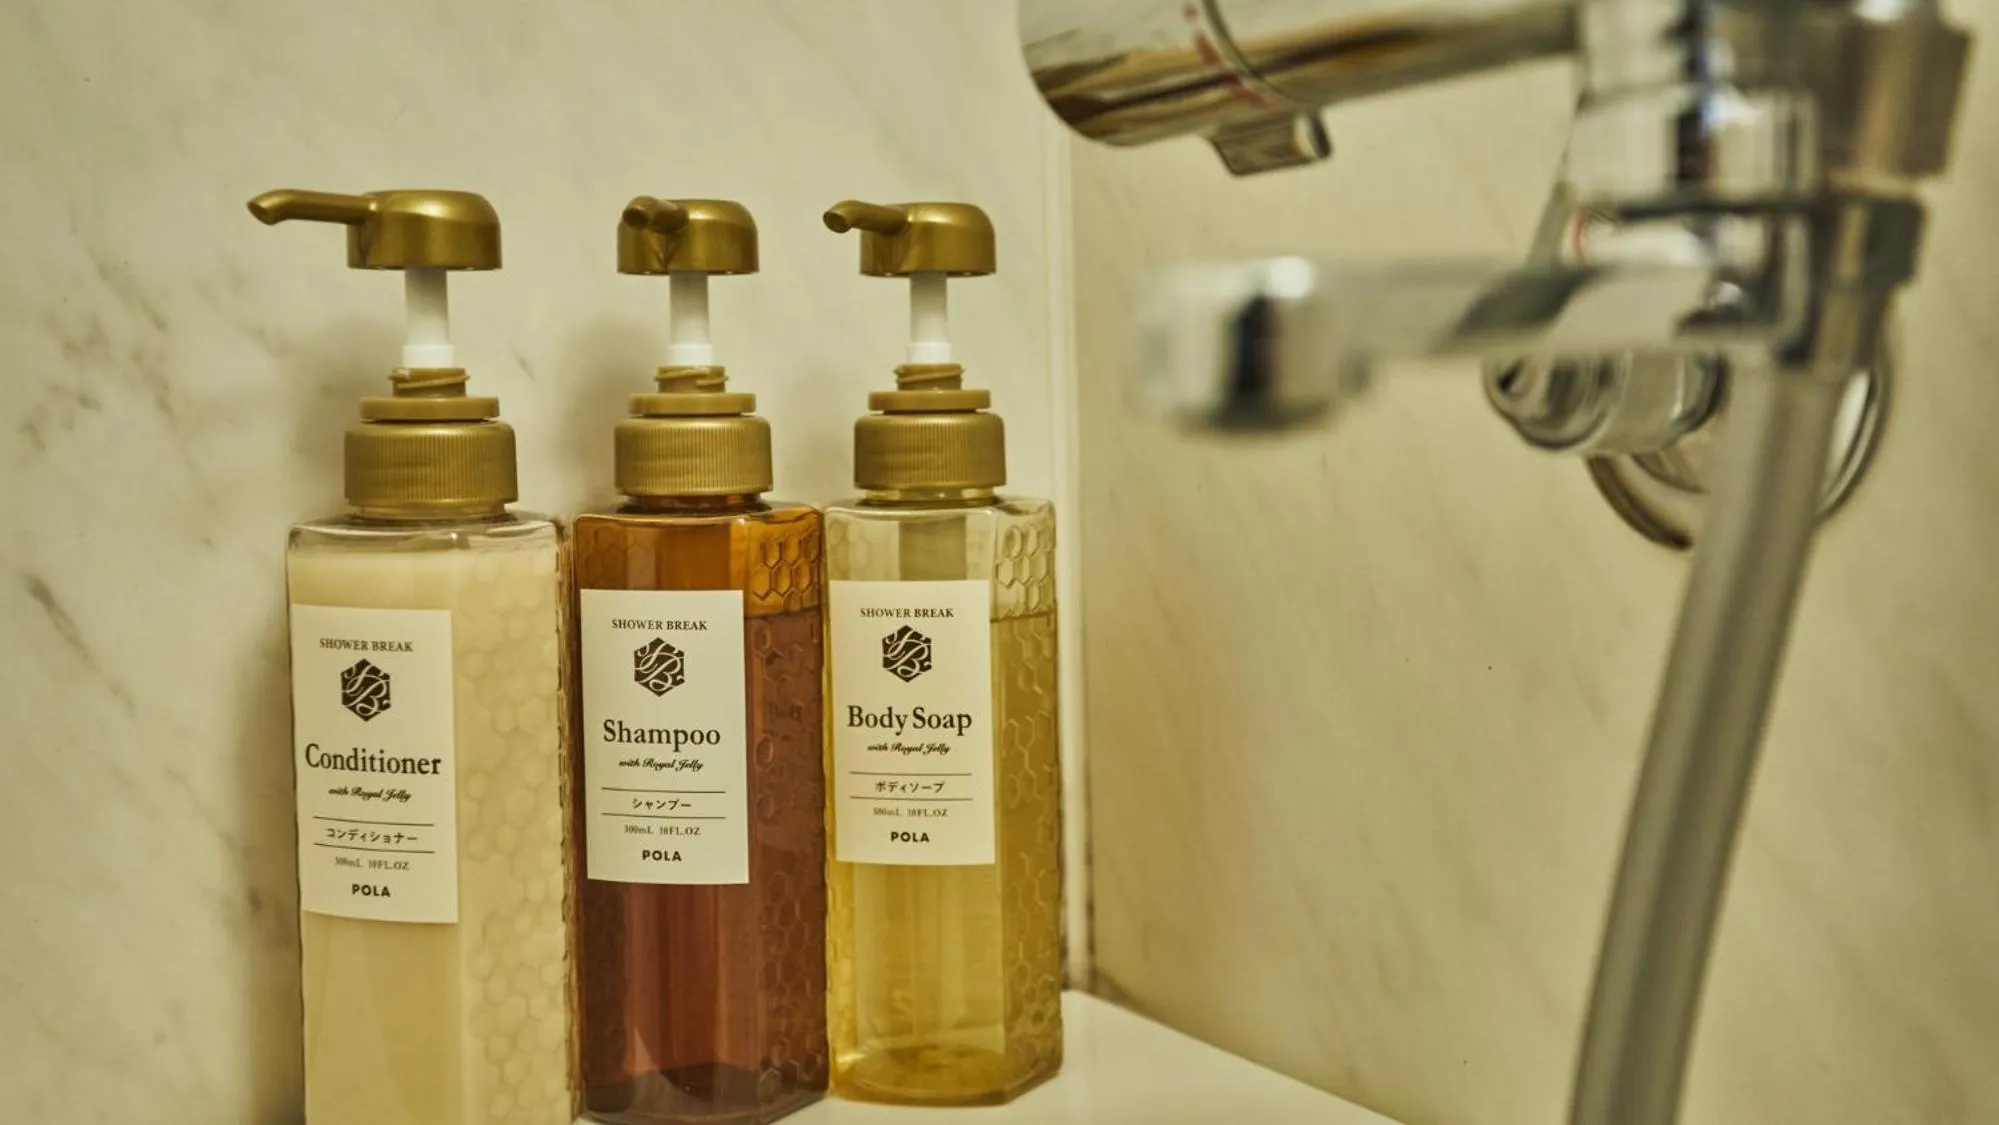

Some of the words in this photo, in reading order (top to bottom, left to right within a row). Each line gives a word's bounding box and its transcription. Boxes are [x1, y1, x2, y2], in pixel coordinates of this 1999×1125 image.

[860, 608, 912, 618] SHOWER
[914, 608, 955, 618] BREAK
[611, 619, 663, 630] SHOWER
[666, 620, 708, 631] BREAK
[320, 638, 368, 651] SHOWER
[372, 641, 414, 652] BREAK
[847, 705, 908, 736] Body
[912, 706, 972, 736] Soap
[603, 719, 720, 752] Shampoo
[867, 743, 888, 752] with
[891, 743, 923, 756] Royal
[922, 743, 950, 755] Jelly
[305, 743, 442, 775] Conditioner
[619, 760, 641, 768] with
[642, 758, 676, 771] Royal
[675, 759, 703, 772] Jelly
[328, 786, 349, 796] with
[351, 787, 383, 801] Royal
[383, 789, 411, 803] Jelly
[632, 798, 692, 810] シャンプー
[326, 828, 418, 844] コンディショナー
[890, 832, 930, 843] POLA
[642, 850, 682, 862] POLA
[352, 884, 391, 897] POLA
